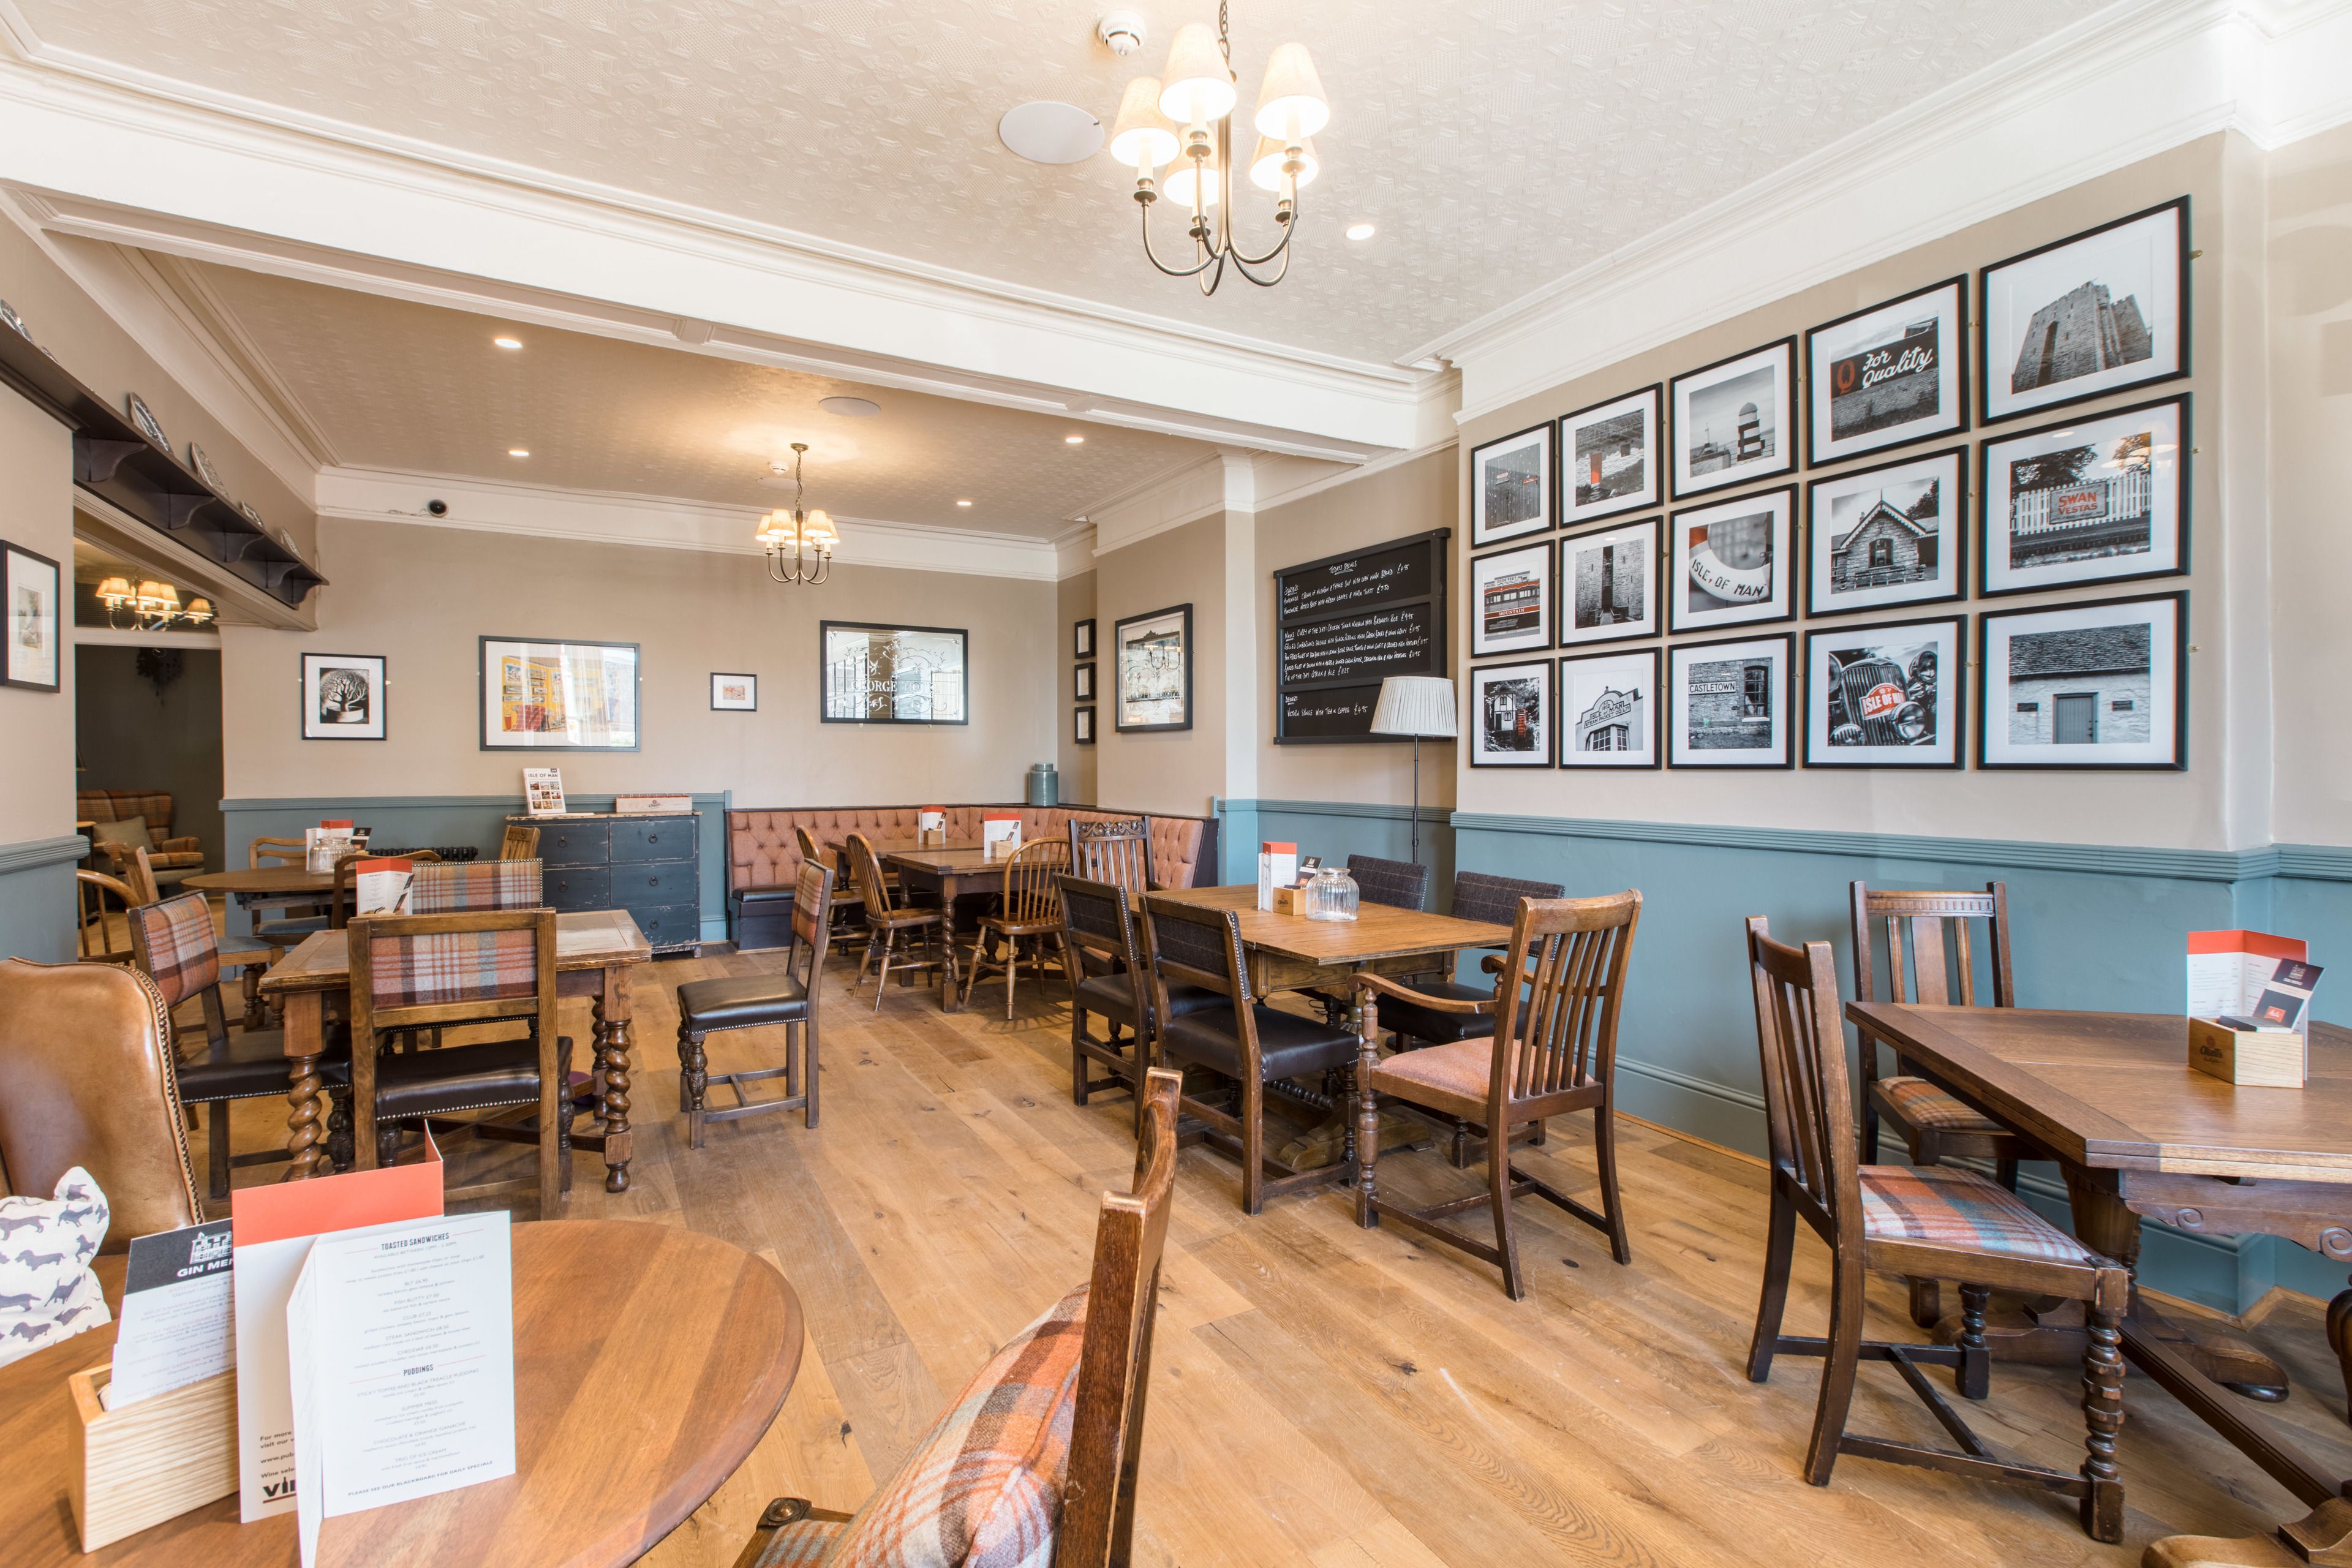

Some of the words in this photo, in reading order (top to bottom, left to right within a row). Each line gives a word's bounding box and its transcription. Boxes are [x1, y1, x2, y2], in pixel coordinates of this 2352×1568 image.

[1838, 359, 1855, 395] Q
[1863, 350, 1891, 371] For
[1862, 346, 1933, 389] Quality
[2059, 492, 2097, 507] SWAN
[2058, 503, 2097, 514] VESTAS
[1692, 559, 1710, 581] ISLE
[1715, 576, 1730, 589] OF
[1734, 584, 1764, 596] MAN
[1284, 596, 1298, 605] HOMEMADE
[1284, 606, 1298, 615] HOMEMADE
[852, 680, 897, 692] GEORGE
[1689, 682, 1735, 693] CASTLETOWN
[1862, 696, 1882, 714] ISLE
[1882, 693, 1891, 705] OF
[1599, 712, 1614, 722] PACKET
[382, 1240, 408, 1250] TOASTED
[410, 1232, 450, 1245] SANDWICHES
[177, 1265, 204, 1276] GIN
[404, 1329, 435, 1337] SANDWICH
[404, 1364, 434, 1376] PUDDINGS
[430, 1374, 452, 1383] TREACLE
[454, 1368, 479, 1376] PUDDING
[374, 1434, 407, 1444] CHOCOLATE
[439, 1421, 466, 1431] GANACHE
[261, 1452, 294, 1463] www.pub
[397, 1474, 435, 1485] BLACKBOARD
[467, 1461, 492, 1469] SPECIALS
